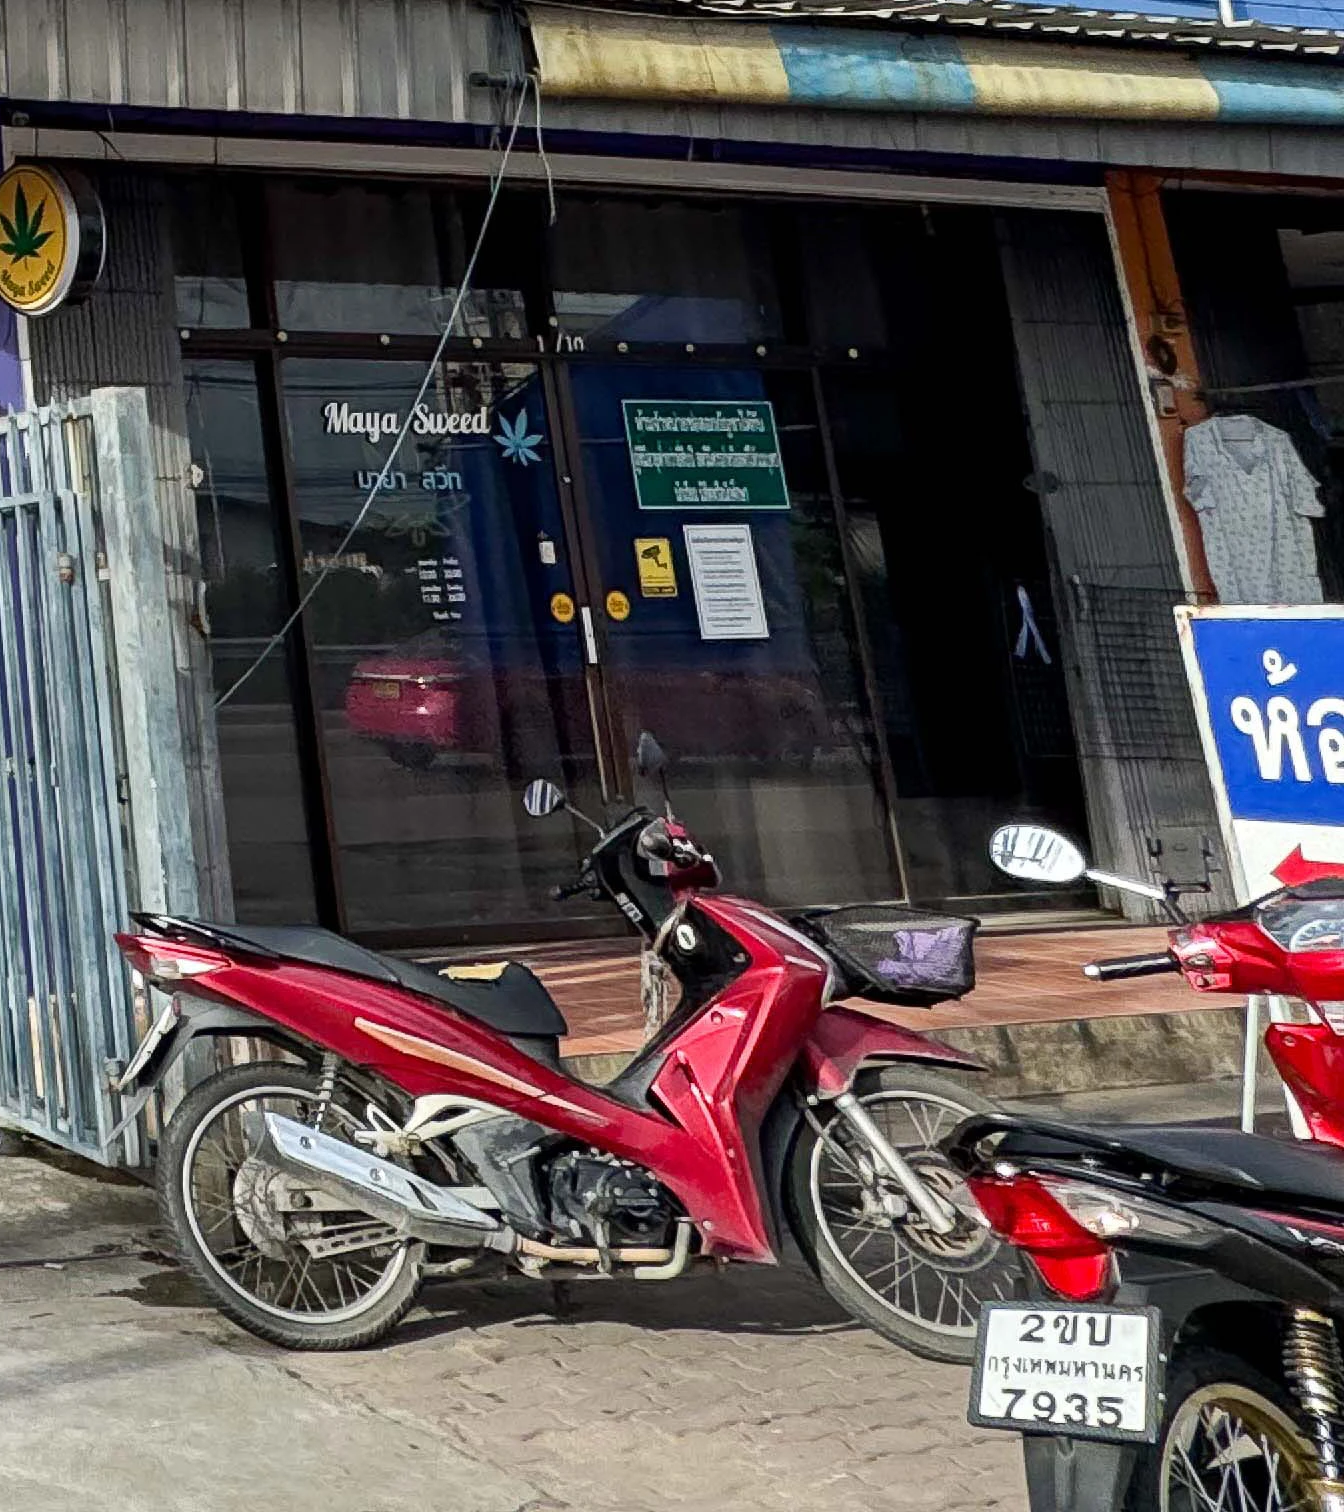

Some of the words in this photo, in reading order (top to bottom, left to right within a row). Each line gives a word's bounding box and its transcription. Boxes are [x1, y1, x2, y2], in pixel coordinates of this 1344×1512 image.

[324, 402, 400, 444] Maya
[414, 402, 491, 435] Sweed
[988, 1355, 1144, 1382] กรุงเทพมหานคร
[1001, 1388, 1124, 1428] 7935
